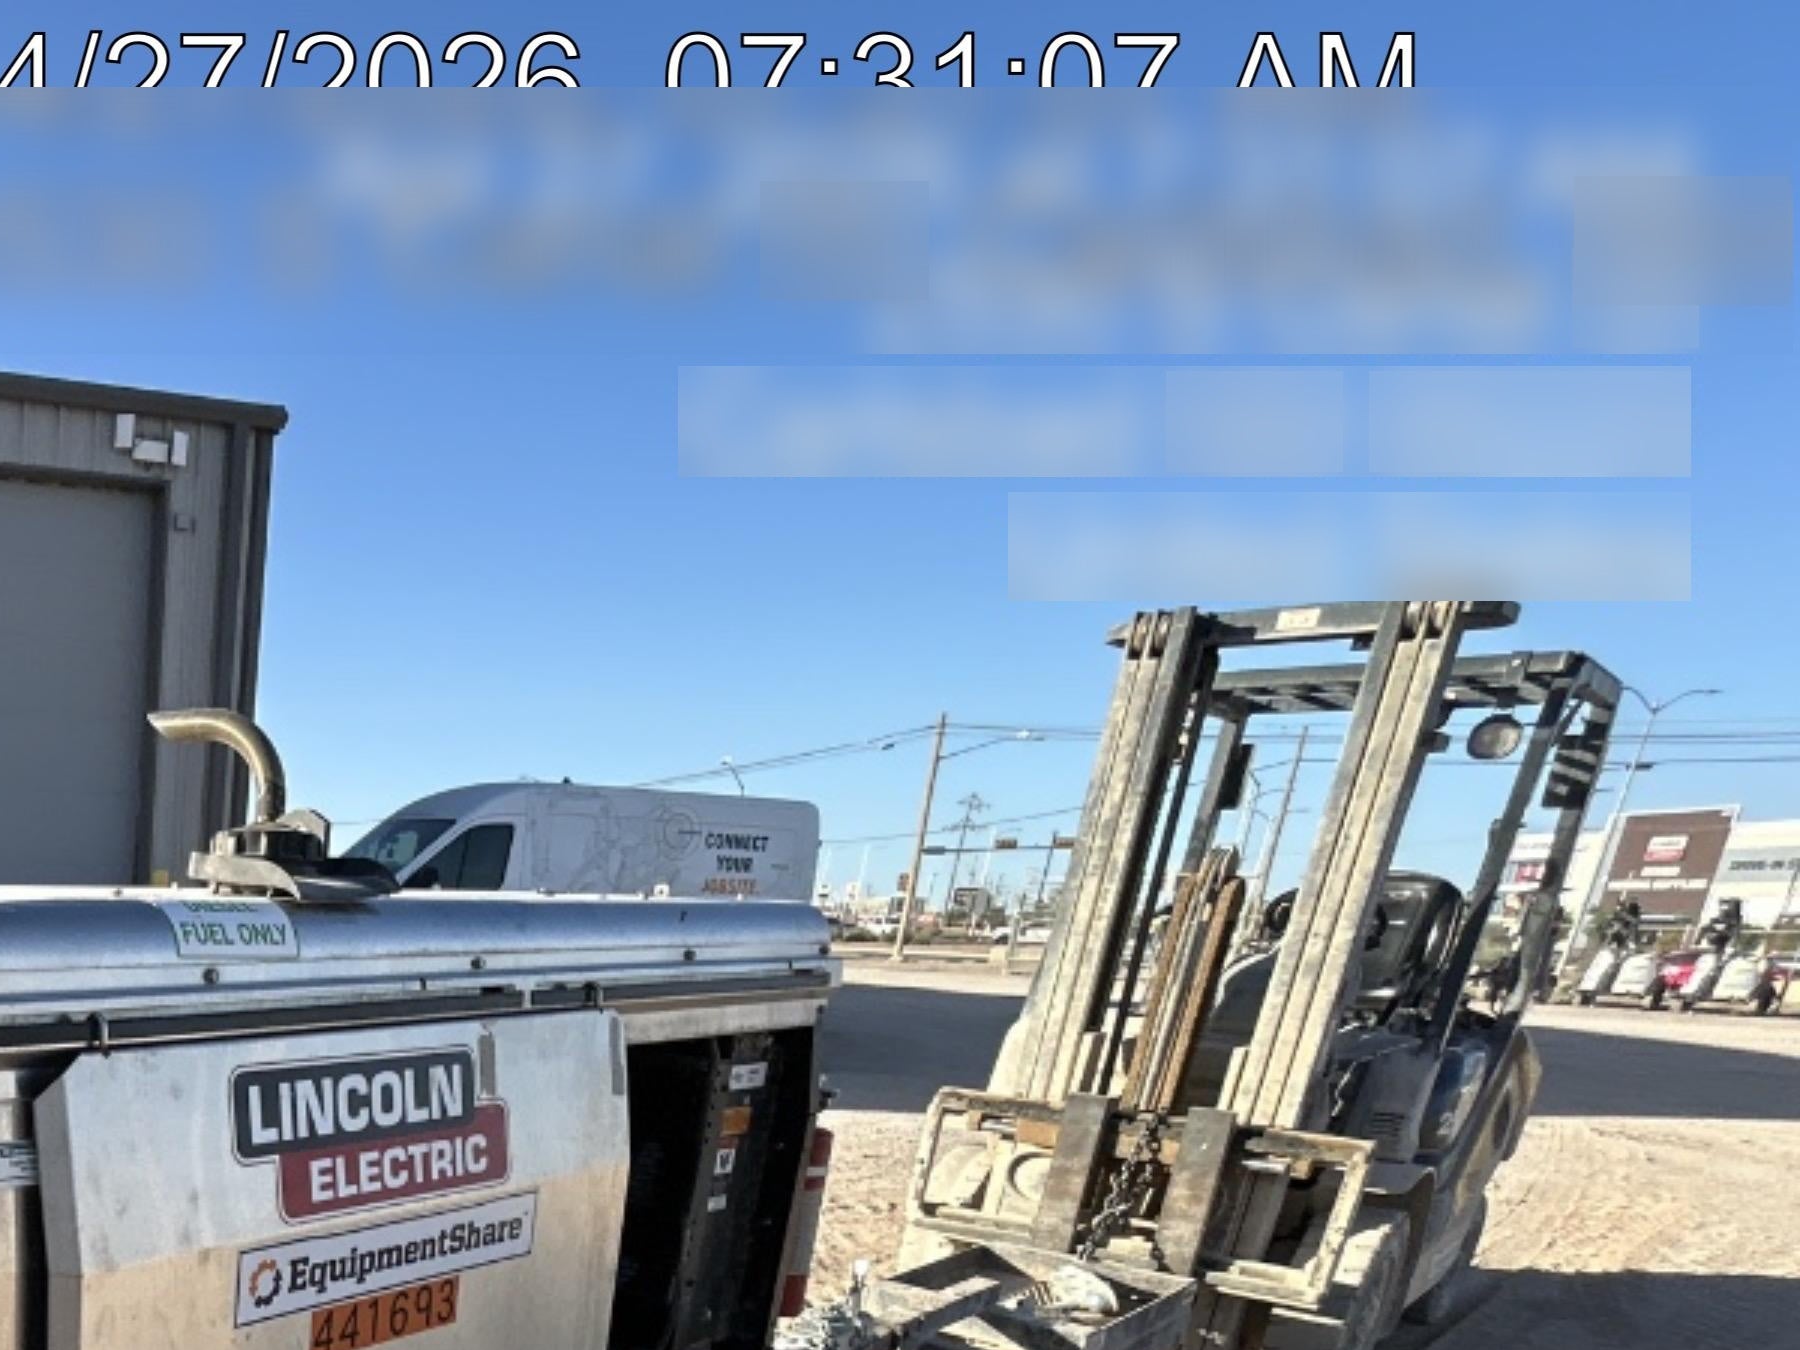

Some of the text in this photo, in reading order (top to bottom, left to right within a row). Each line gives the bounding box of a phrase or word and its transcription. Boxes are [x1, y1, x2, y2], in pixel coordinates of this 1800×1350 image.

[705, 833, 769, 853] CONNECT
[716, 855, 753, 873] YOUR
[180, 922, 285, 945] FUEL ONLY
[248, 1064, 464, 1146] LINCOLN
[309, 1133, 488, 1204] ELECTRIC
[287, 1217, 523, 1294] EquipmentShare
